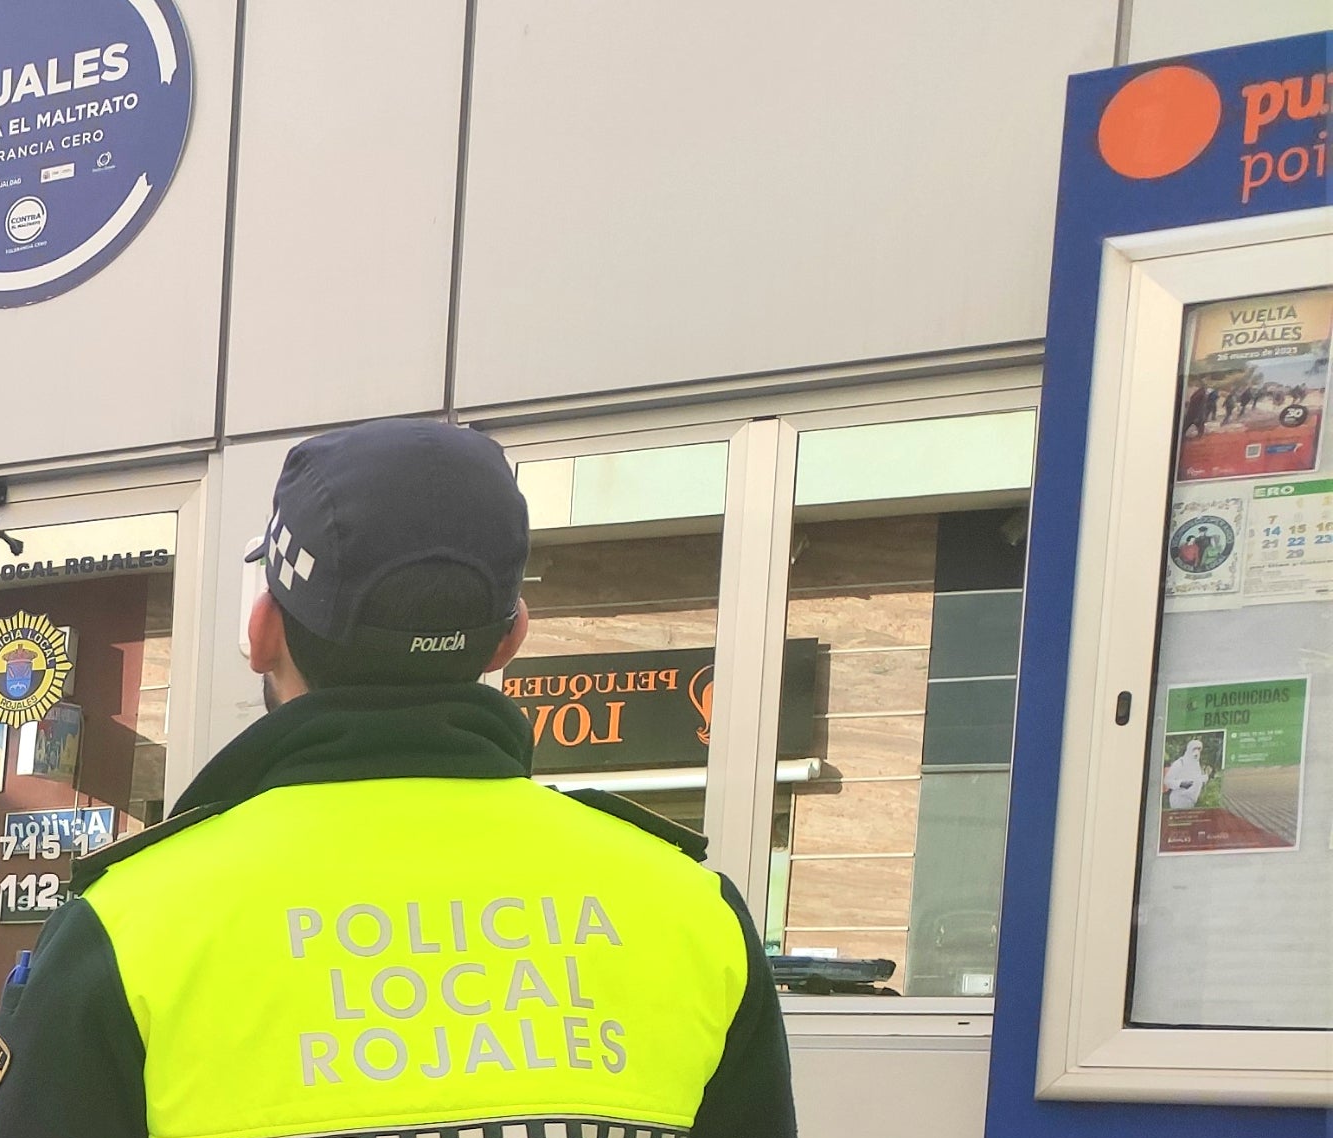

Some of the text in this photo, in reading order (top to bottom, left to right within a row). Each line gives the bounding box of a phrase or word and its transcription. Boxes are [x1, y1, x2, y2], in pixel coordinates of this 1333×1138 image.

[8, 117, 31, 137] EL
[36, 92, 139, 131] MALTRATO
[1241, 71, 1333, 144] pu
[60, 129, 104, 149] CERO
[11, 212, 41, 224] CONTRA
[1230, 304, 1298, 326] VUELTA
[1221, 326, 1303, 349] ROJALES
[64, 549, 169, 575] ROJALES
[27, 629, 57, 665] LOCAL
[410, 630, 466, 653] POLICÍA
[0, 694, 38, 710] ROJALES
[1204, 688, 1291, 708] PLAGUICIDAS
[0, 833, 61, 861] 715
[0, 873, 61, 909] 112
[285, 895, 624, 959] POLICIA
[329, 954, 597, 1021] LOCAL
[298, 1014, 629, 1087] ROJALES
